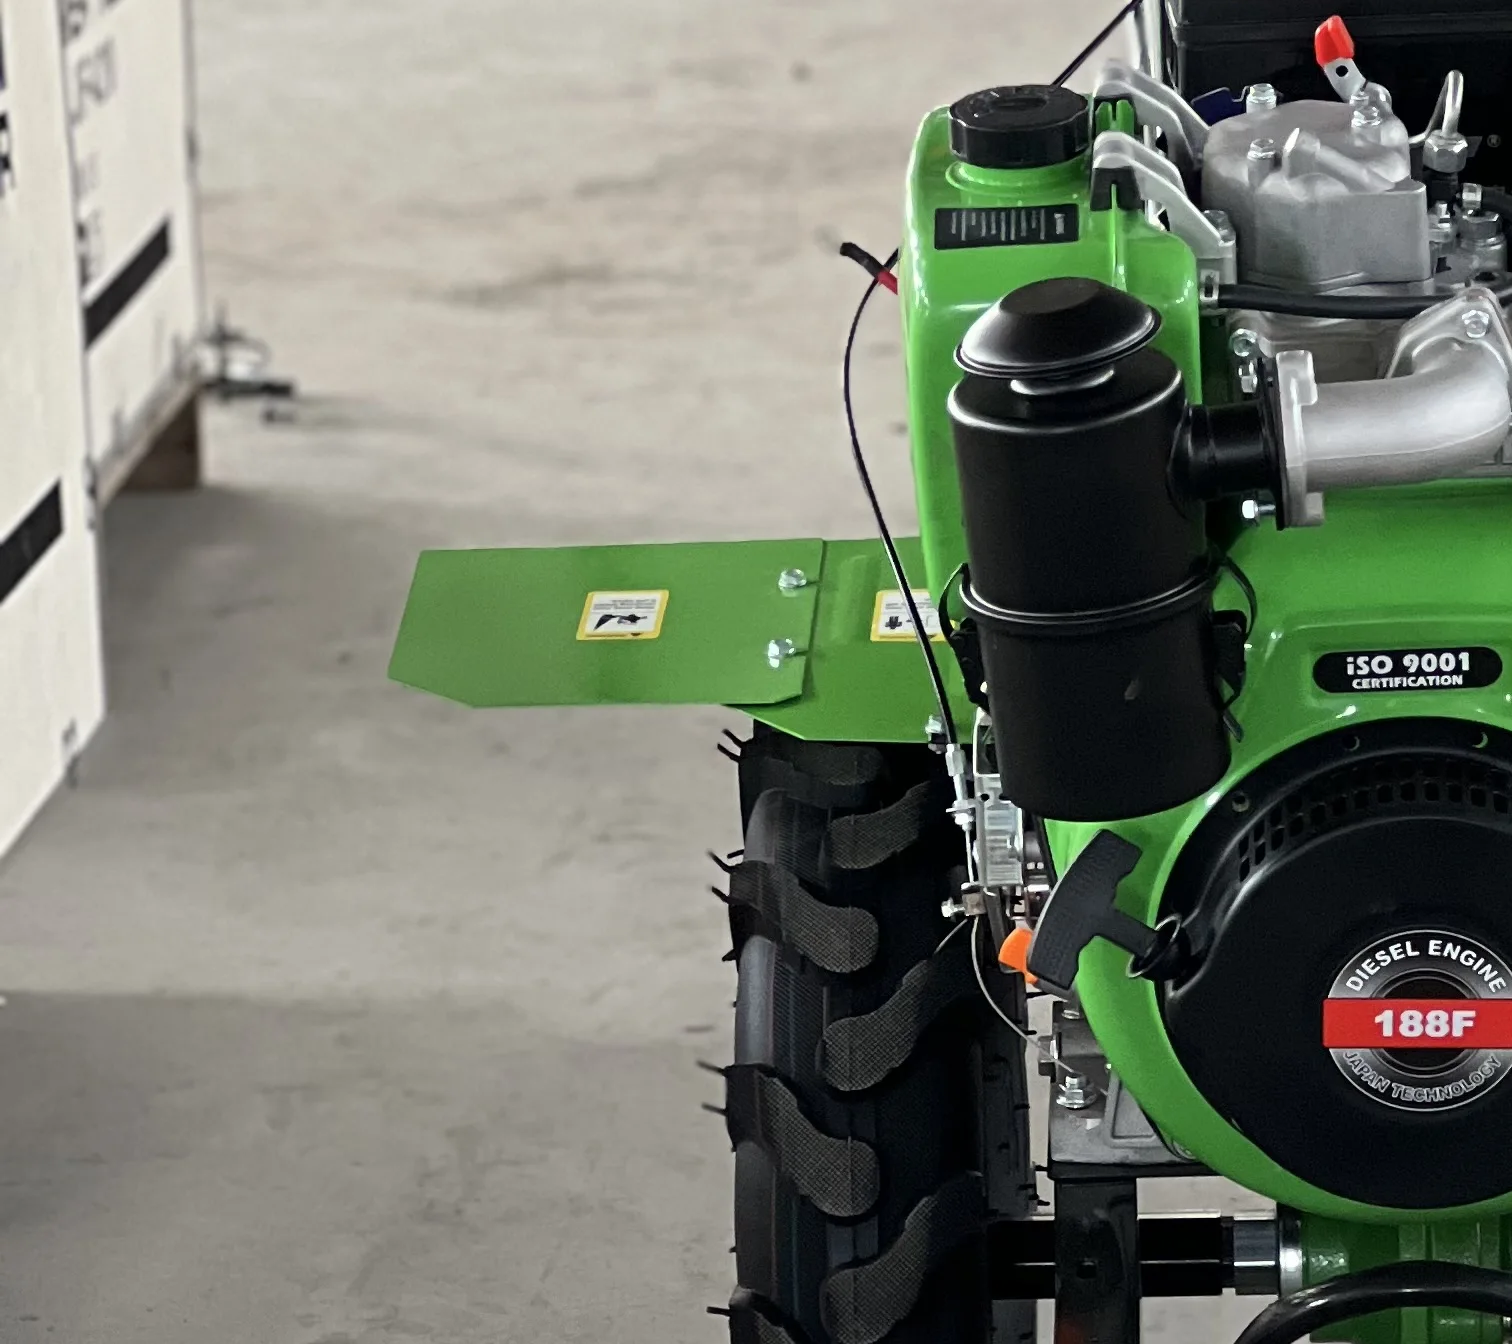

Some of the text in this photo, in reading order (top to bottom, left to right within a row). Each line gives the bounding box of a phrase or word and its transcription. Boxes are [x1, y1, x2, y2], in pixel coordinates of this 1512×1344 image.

[1402, 652, 1470, 673] 9001
[1351, 675, 1464, 689] CERTIFICATION
[1345, 939, 1506, 993] DIESEL ENGINE
[1374, 1009, 1476, 1038] 188F
[1343, 1051, 1501, 1102] JAPAN TECHNOLOGY
